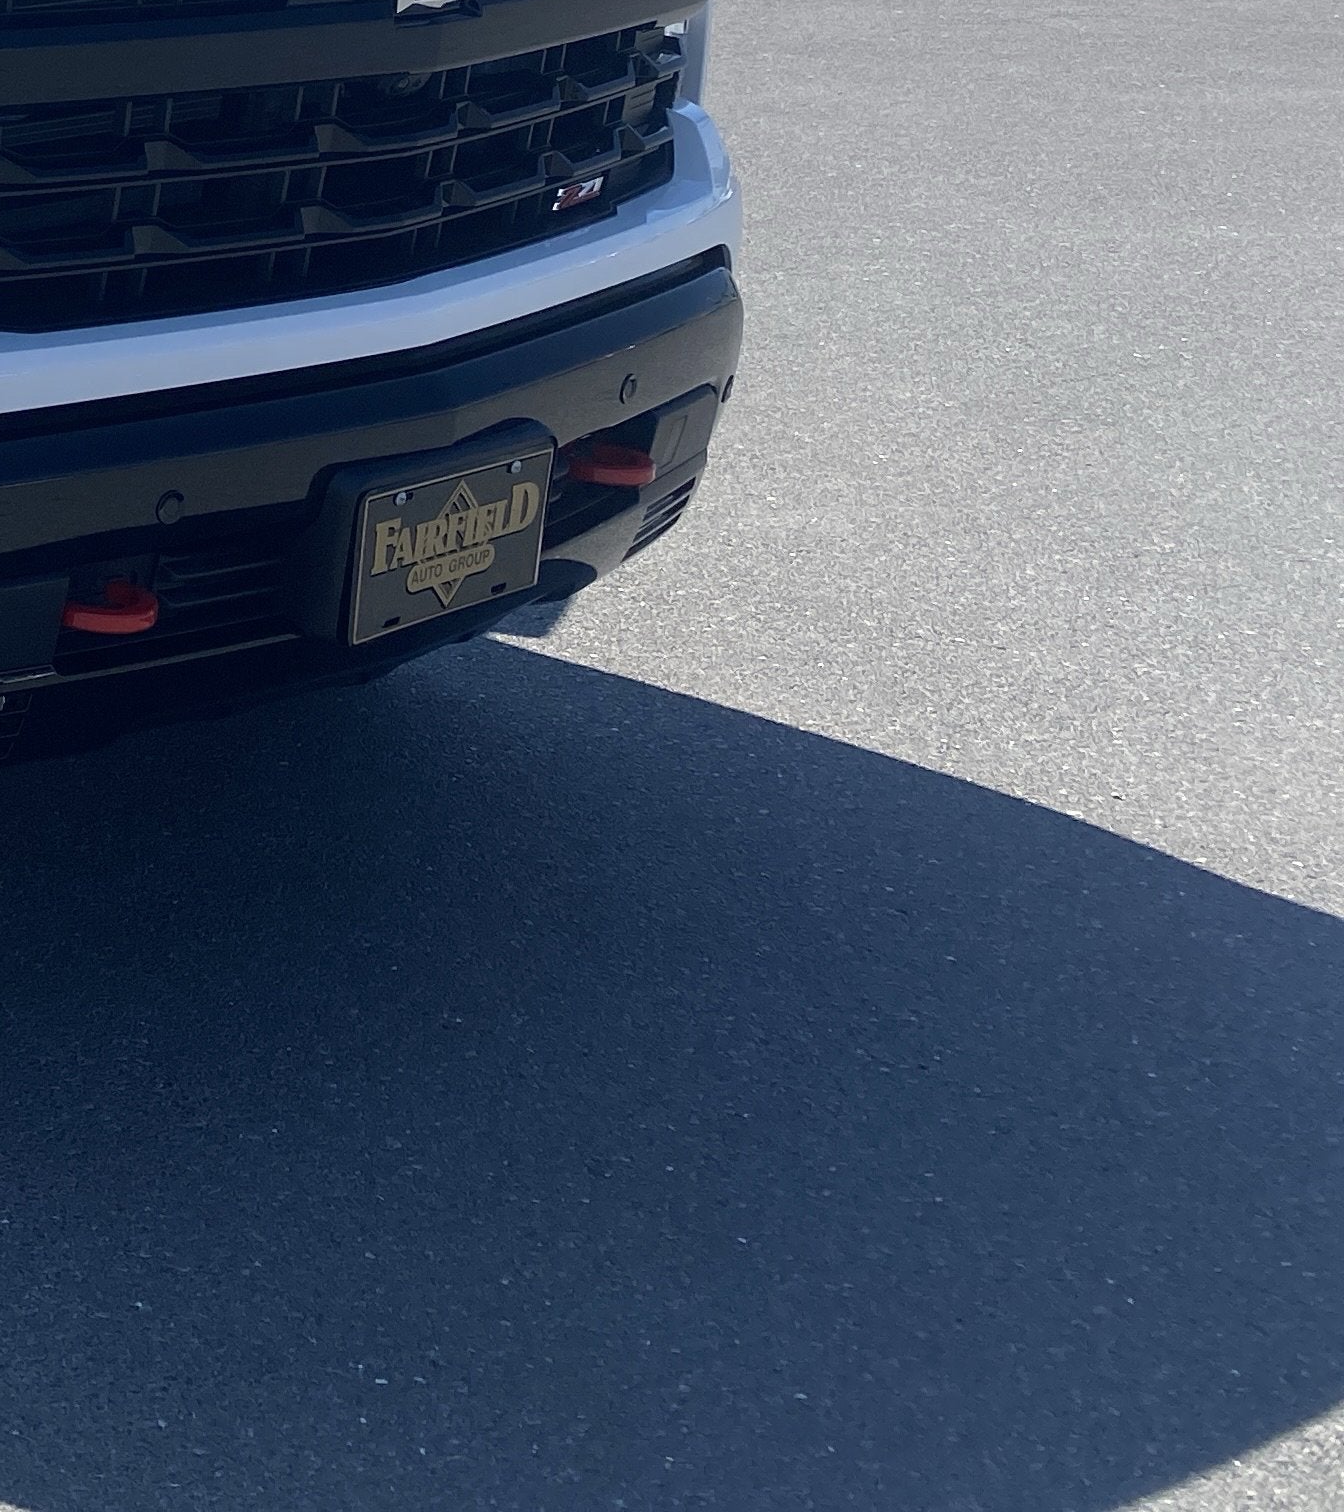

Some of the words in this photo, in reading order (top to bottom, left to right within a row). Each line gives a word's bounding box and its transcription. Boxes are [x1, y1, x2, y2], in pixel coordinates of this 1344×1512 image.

[552, 176, 605, 211] Z71
[370, 481, 540, 576] FAIRFIELD
[411, 563, 444, 585] AUTO
[448, 549, 491, 573] GROUP
